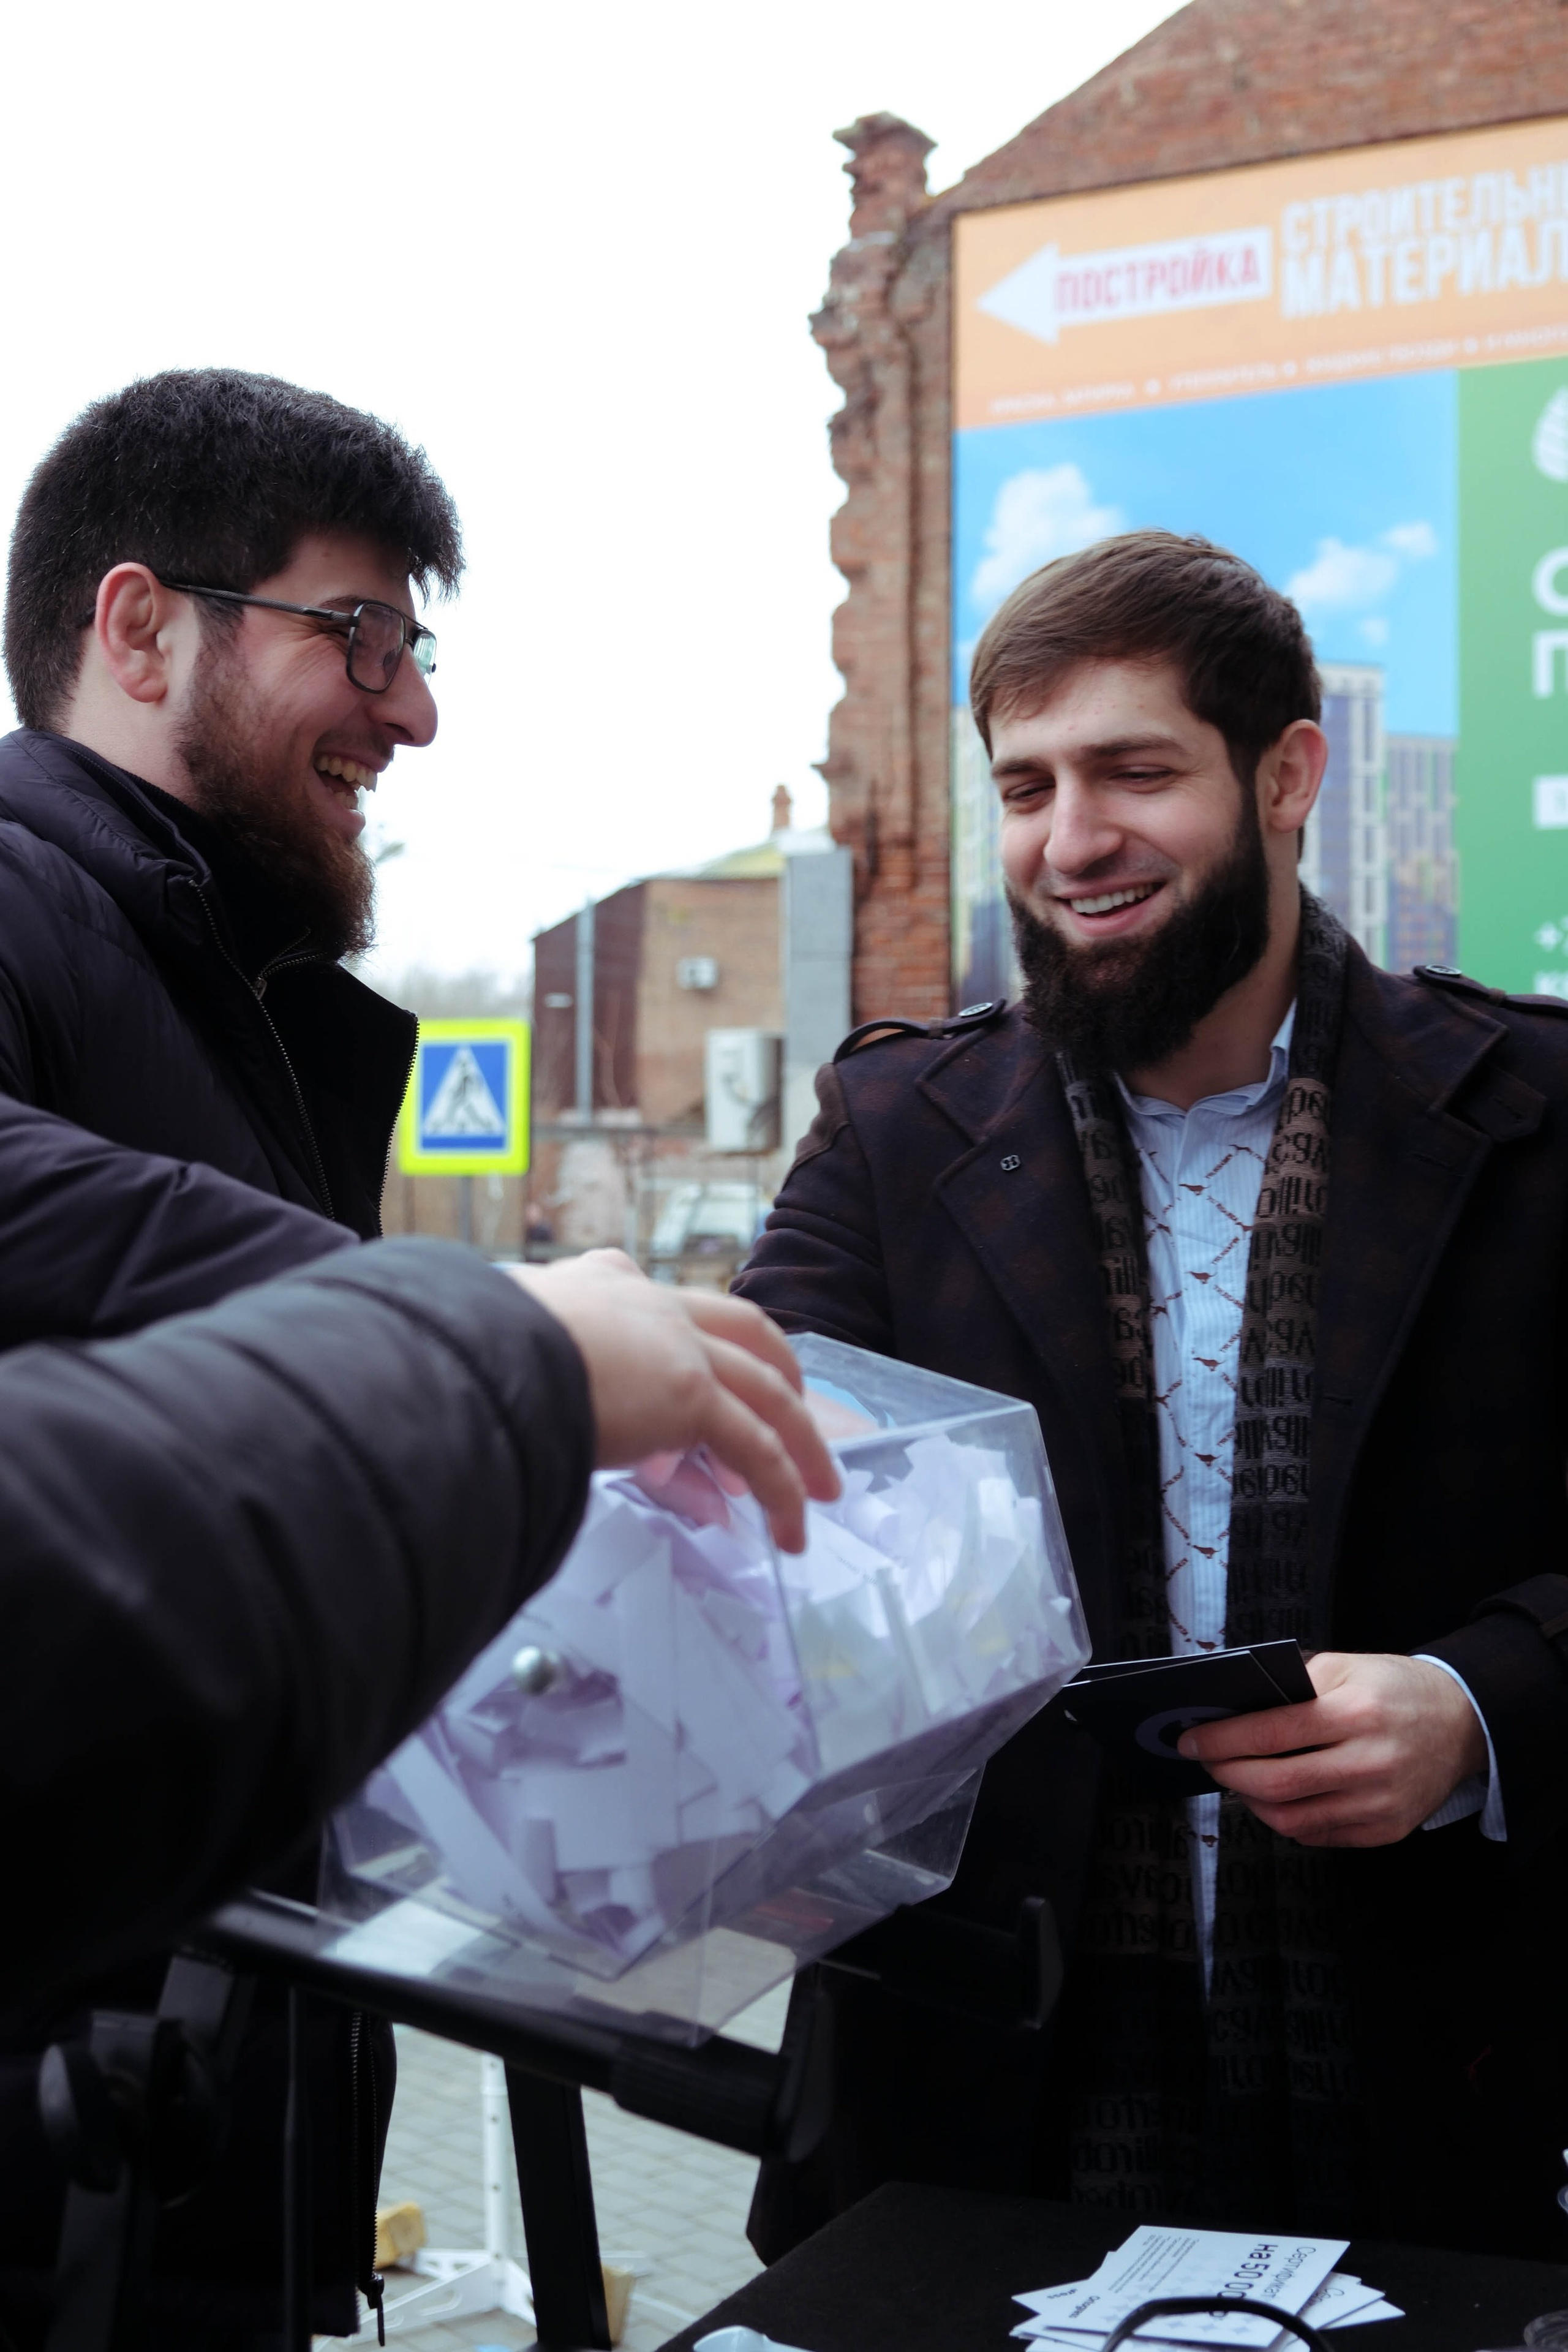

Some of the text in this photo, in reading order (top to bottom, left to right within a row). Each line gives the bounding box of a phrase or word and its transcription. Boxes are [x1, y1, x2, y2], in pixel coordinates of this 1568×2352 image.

[1283, 160, 1568, 252] СТРОИТЕЛЬН
[1055, 244, 1259, 311] ПОСТРОЙКА
[1234, 2263, 1270, 2279] 50
[1248, 2244, 1278, 2260] на
[1261, 2246, 1316, 2298] Сертификат
